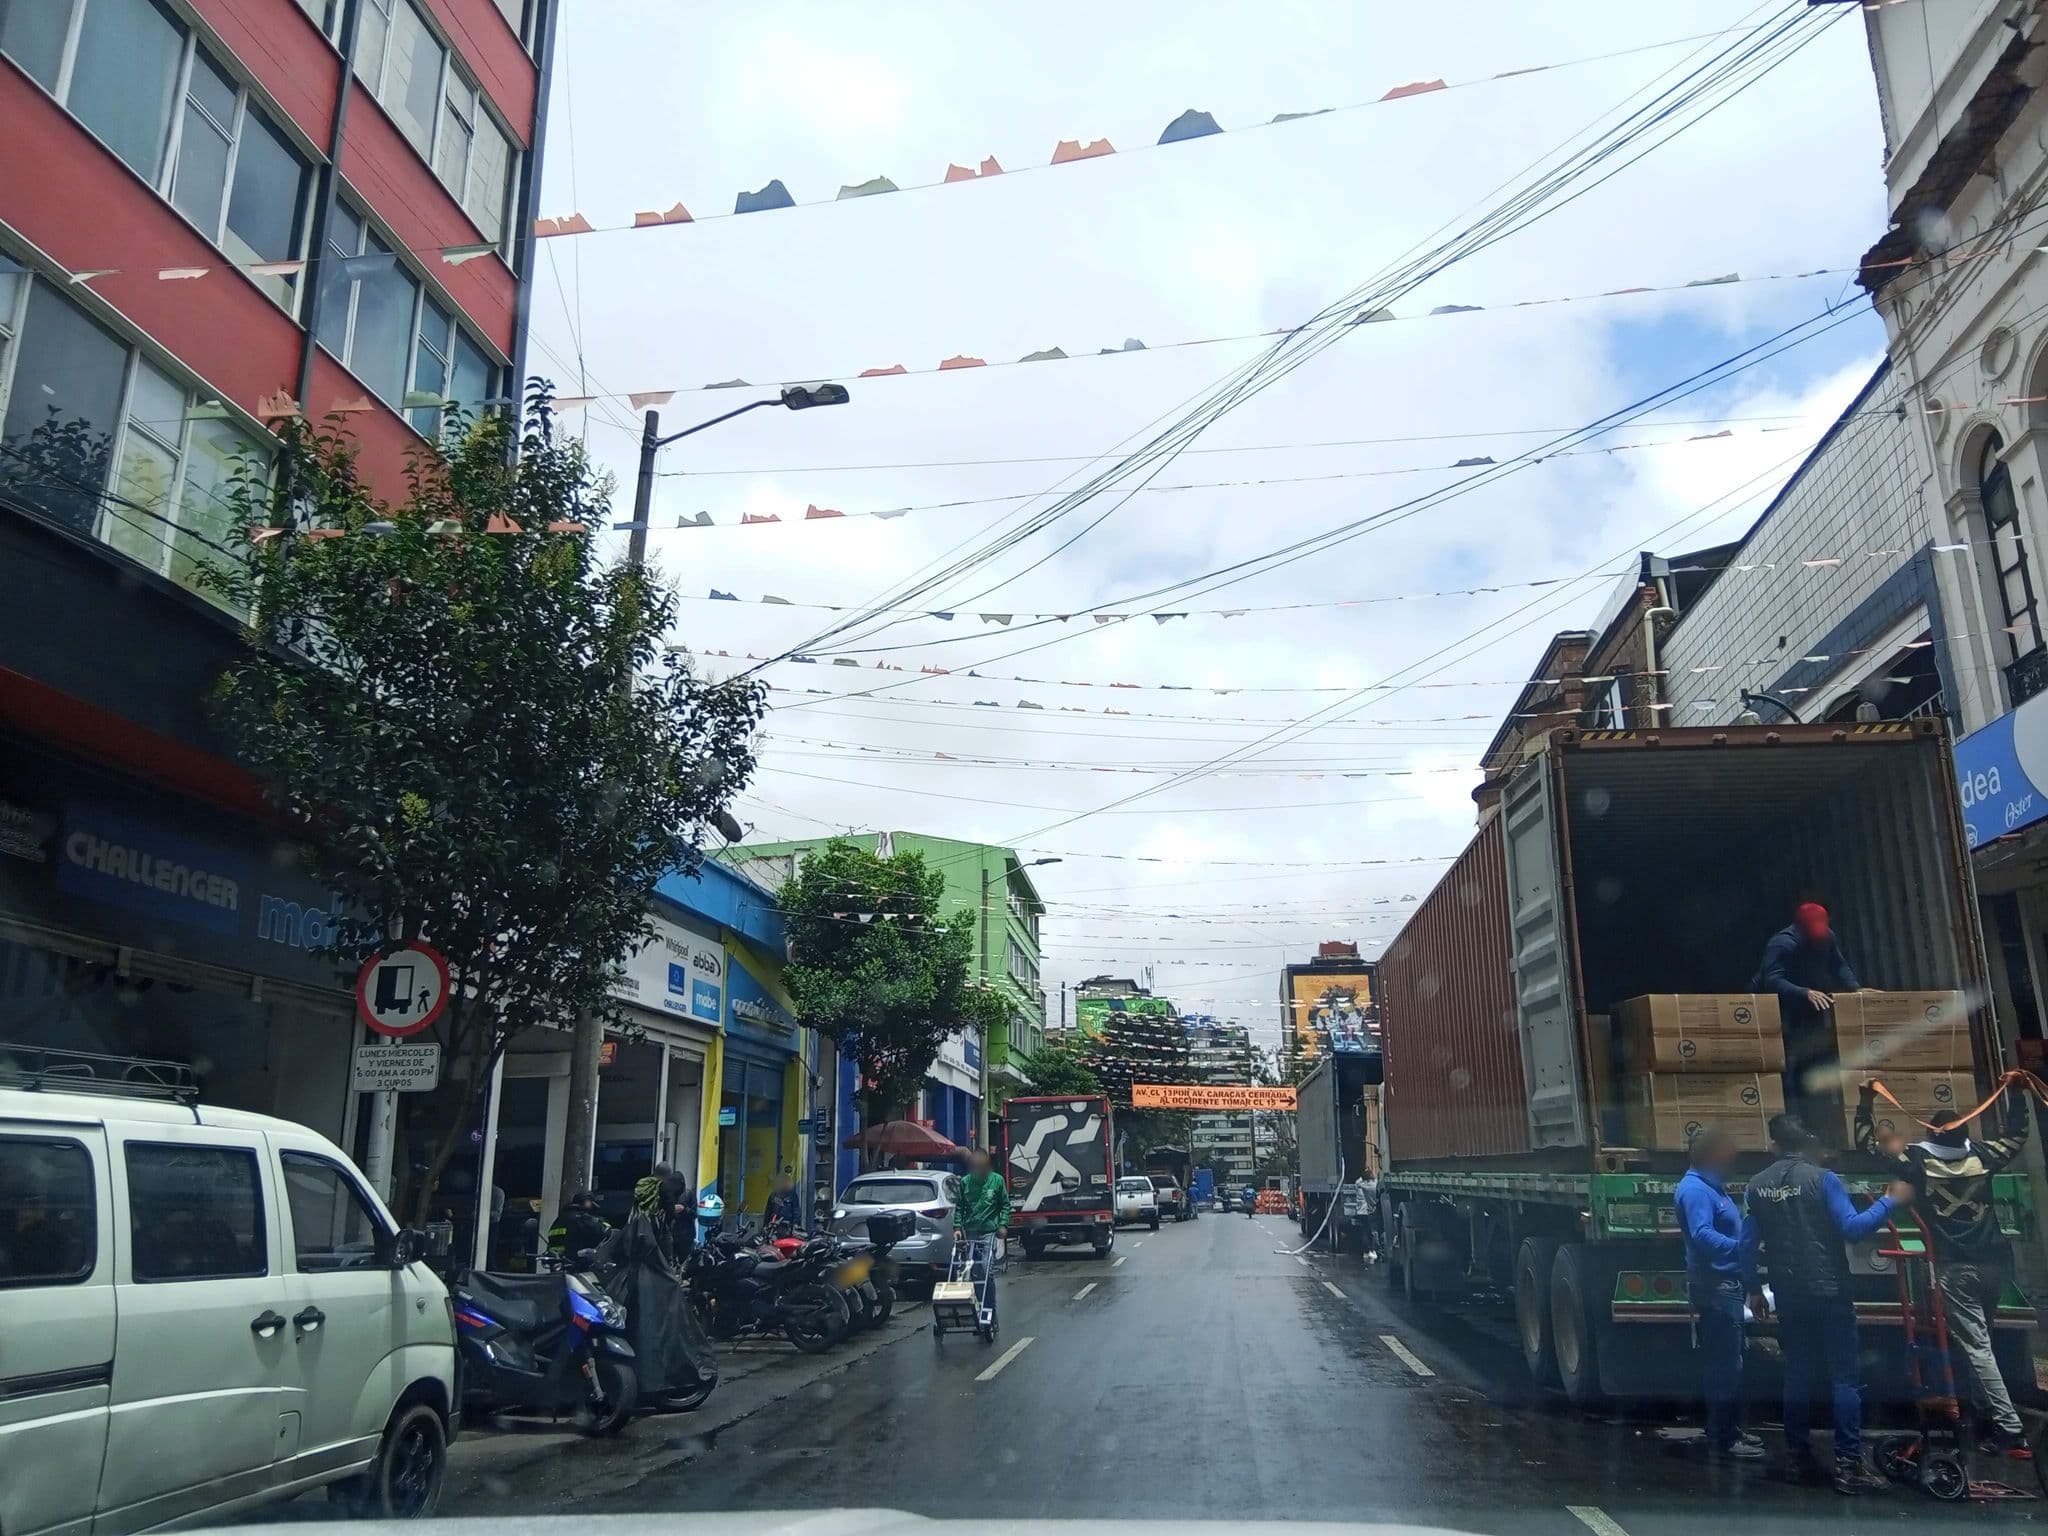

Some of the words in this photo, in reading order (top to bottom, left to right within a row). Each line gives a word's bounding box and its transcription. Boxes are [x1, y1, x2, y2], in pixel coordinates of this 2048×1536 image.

[1961, 766, 2001, 808] dea
[2005, 793, 2032, 828] Oster
[66, 831, 239, 911] CHALLENGER
[693, 952, 715, 973] abba
[696, 990, 717, 1010] mabe
[360, 1049, 386, 1058] LUNES
[376, 1059, 411, 1067] VIERNES
[413, 1058, 424, 1067] DE
[384, 1079, 412, 1087] CUPOS
[1172, 1097, 1219, 1105] OCCIDENTE
[1222, 1098, 1251, 1106] TOMAR
[1206, 1090, 1246, 1098] CARACAS
[1248, 1091, 1288, 1099] CERRADA
[1756, 1184, 1801, 1203] Whirlpool
